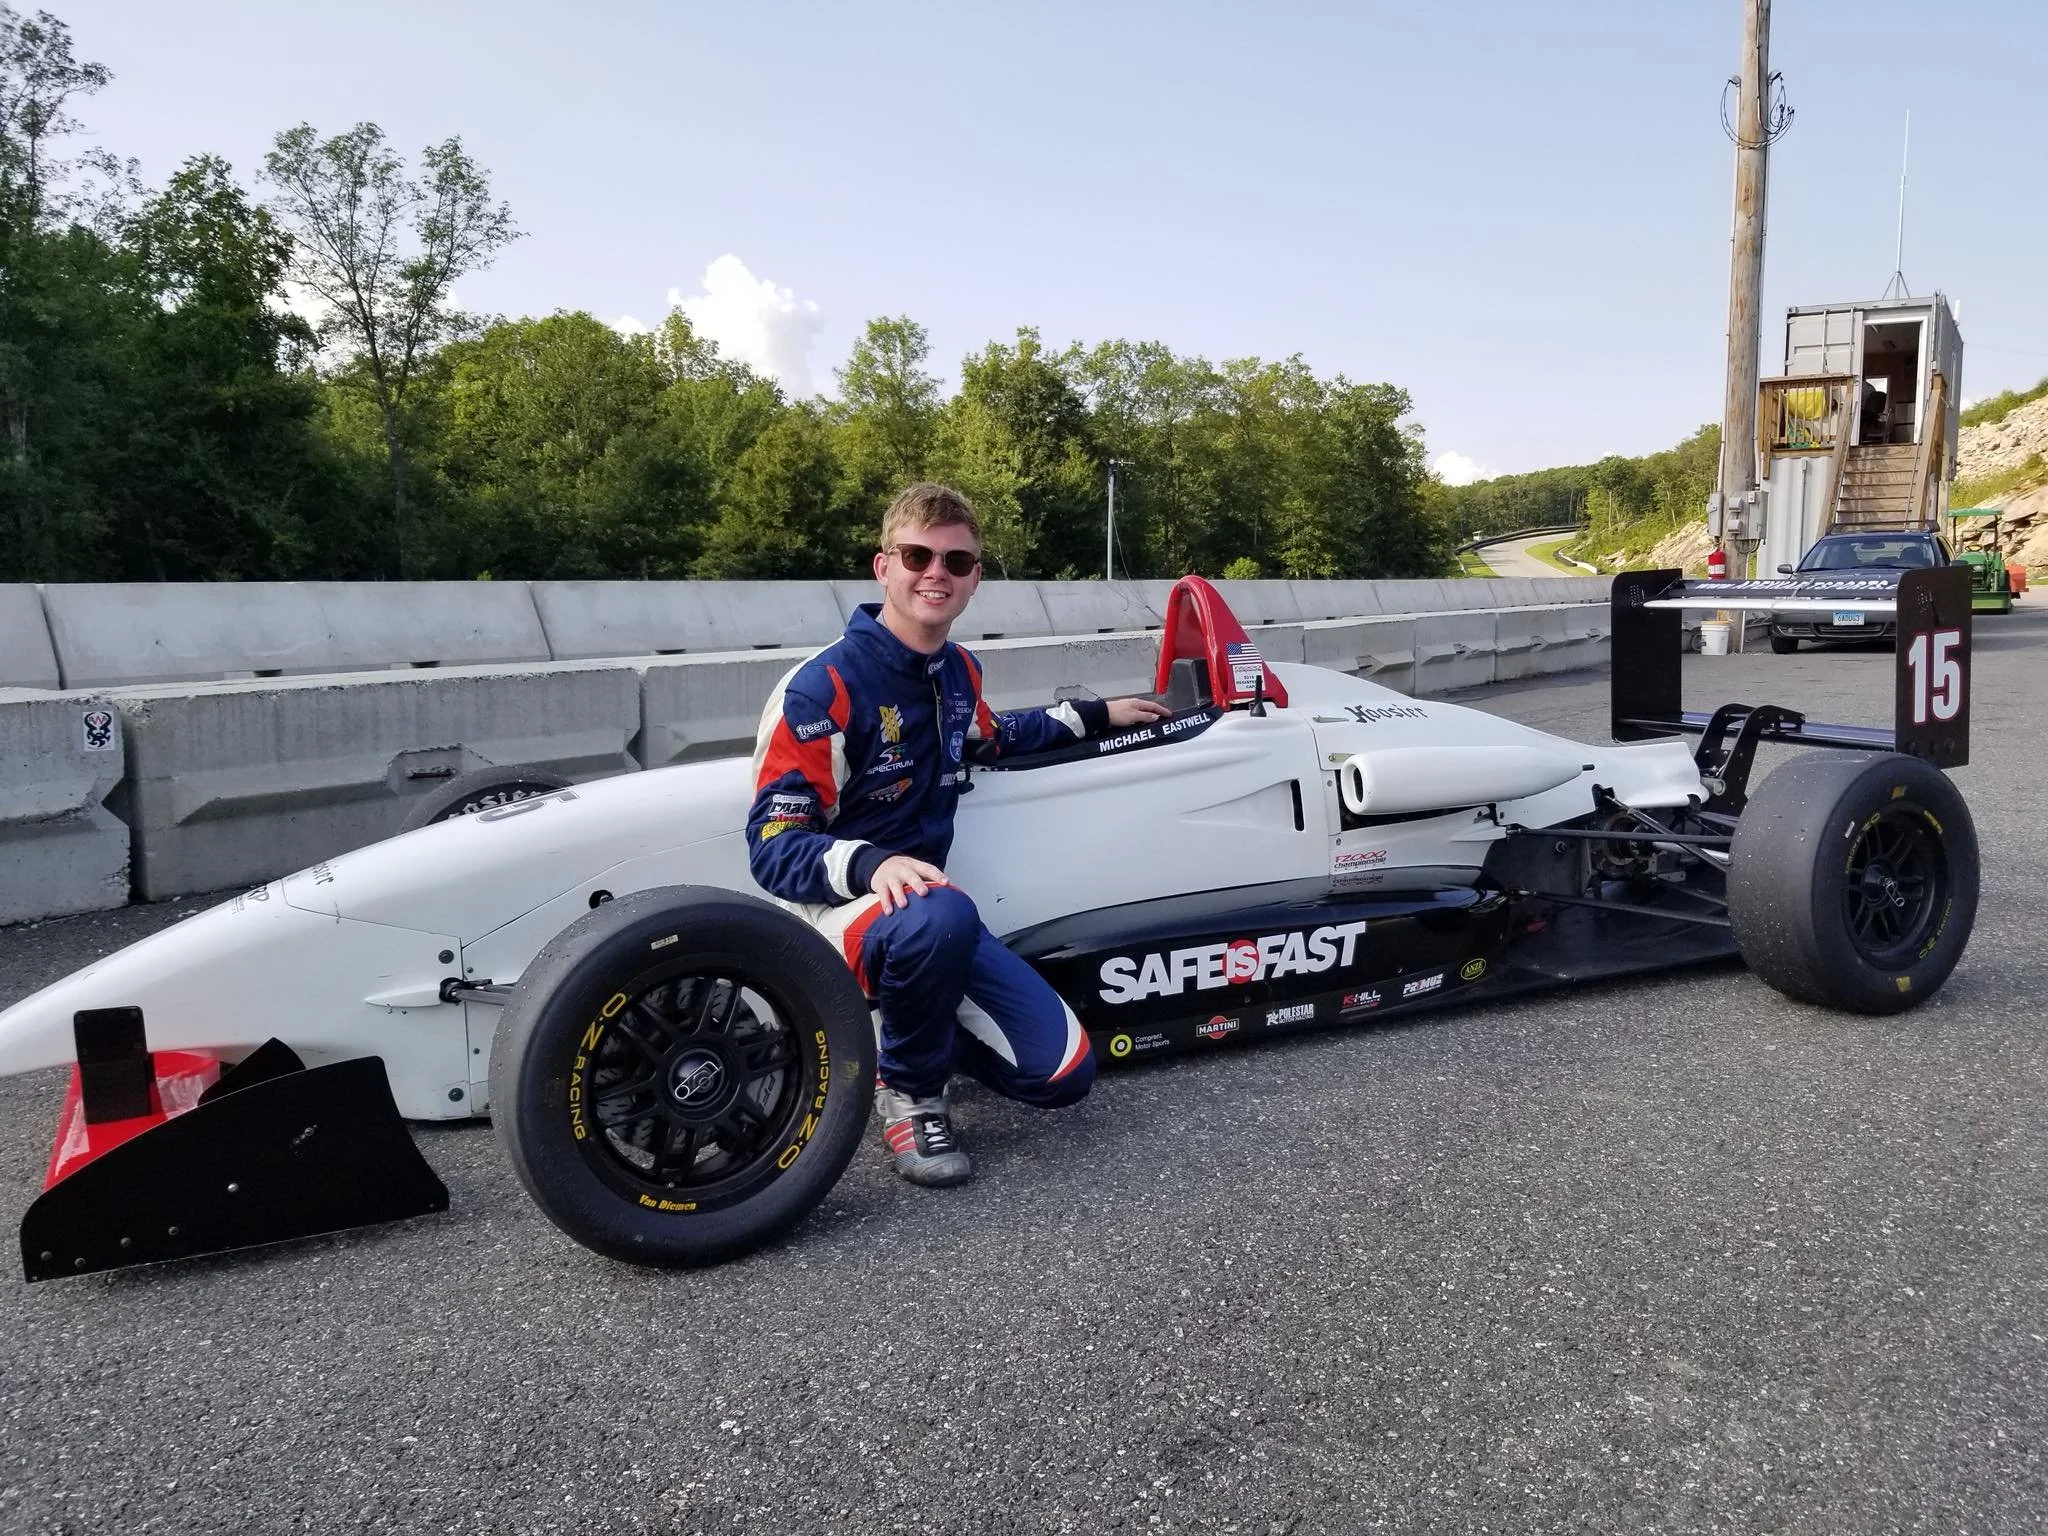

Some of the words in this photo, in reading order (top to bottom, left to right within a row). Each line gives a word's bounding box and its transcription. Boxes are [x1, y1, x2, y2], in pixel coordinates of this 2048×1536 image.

[1907, 630, 1961, 724] 15
[1344, 703, 1428, 723] Hoosier
[797, 719, 832, 739] freem
[1099, 729, 1156, 752] MICHAEL
[1163, 713, 1210, 735] EASTWELL
[1278, 1003, 1315, 1019] POLESTAR
[1199, 1020, 1238, 1035] MARTINI
[1135, 1041, 1151, 1050] Motor
[1152, 1039, 1170, 1048] Sports
[814, 1030, 829, 1109] RACING
[569, 1055, 586, 1140] RACING
[639, 1194, 657, 1208] Van
[658, 1200, 697, 1211] Diemen
